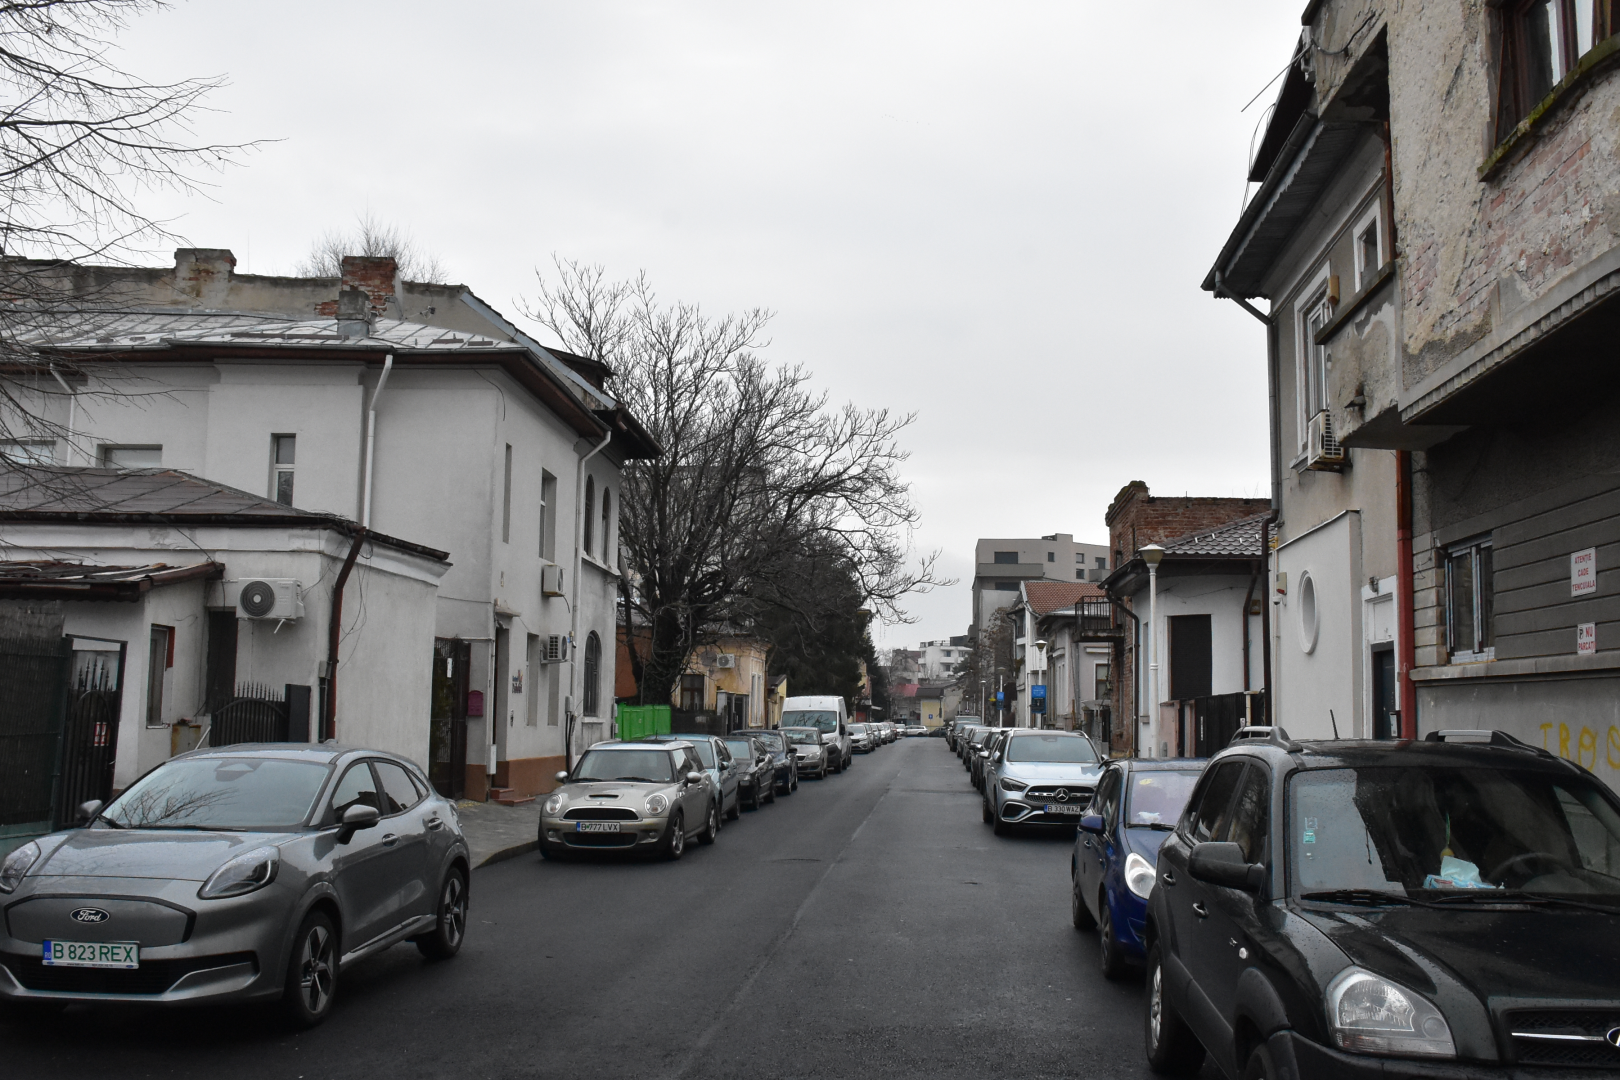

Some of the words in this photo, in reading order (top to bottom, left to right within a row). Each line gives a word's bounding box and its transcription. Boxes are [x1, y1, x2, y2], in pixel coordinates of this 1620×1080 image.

[1578, 567, 1589, 577] CADE
[1586, 626, 1593, 638] NU
[77, 909, 102, 921] Ford
[53, 943, 64, 959] B
[68, 944, 96, 961] 823
[99, 945, 134, 962] REX
